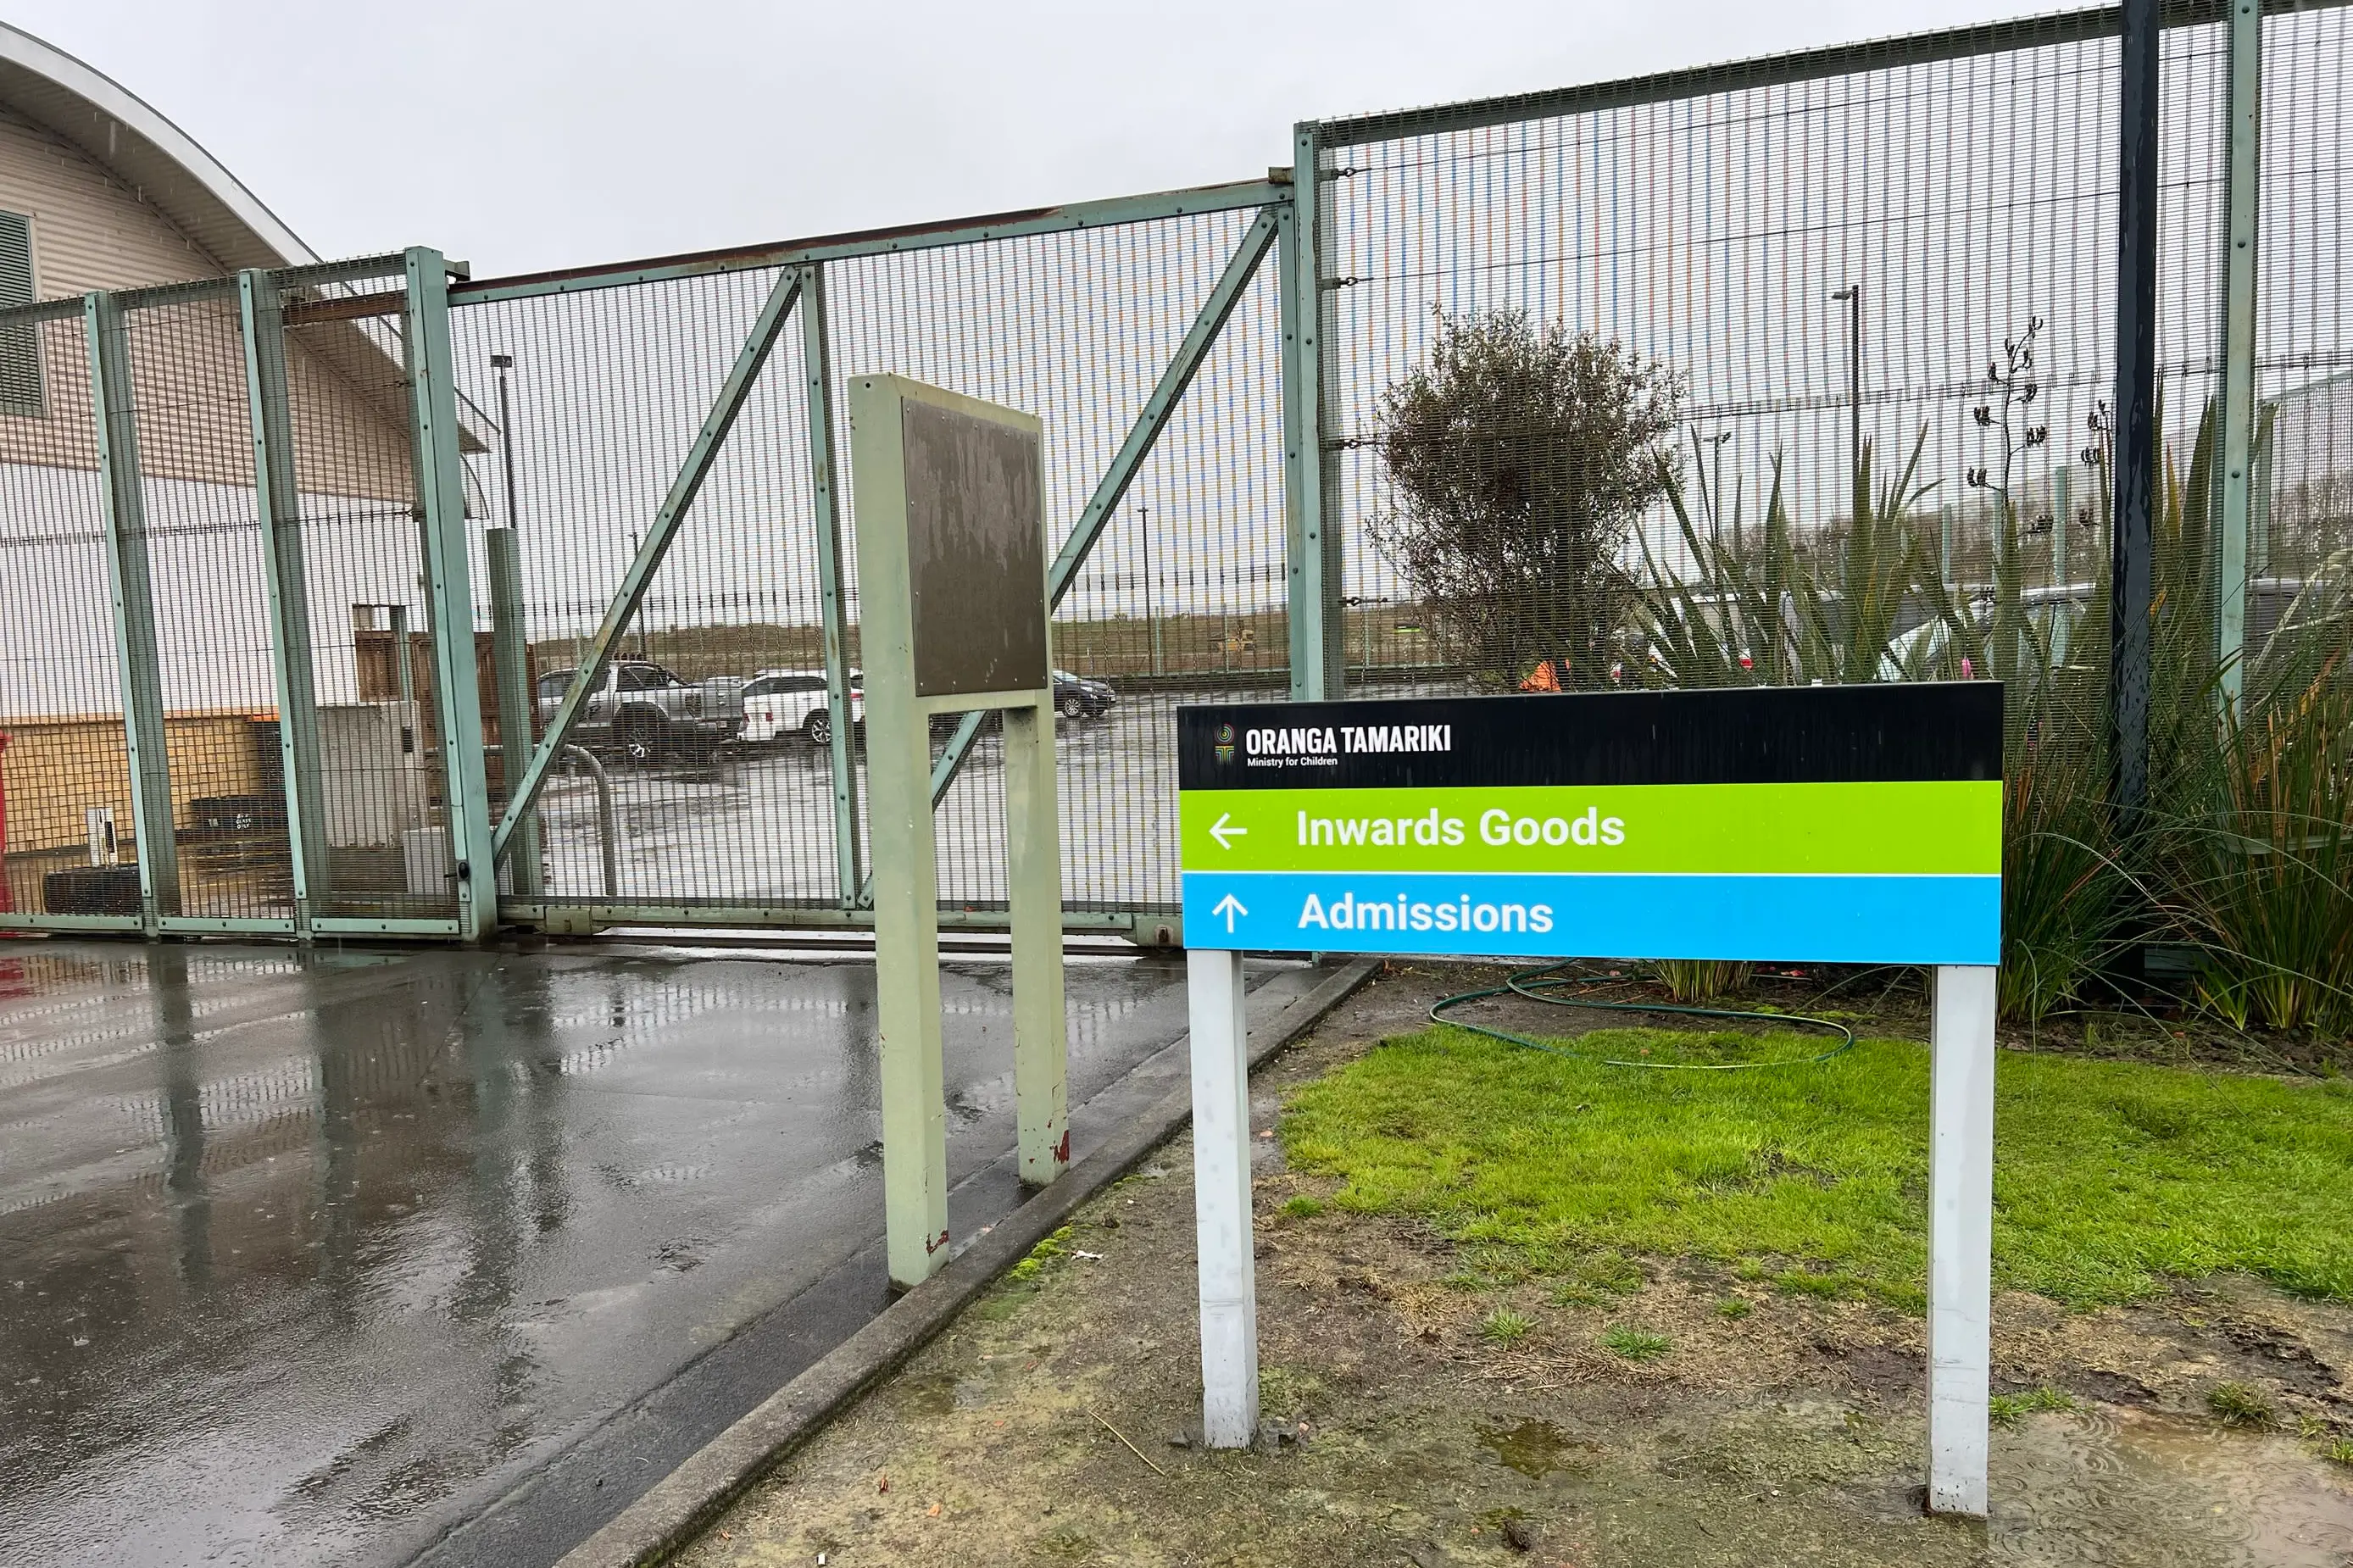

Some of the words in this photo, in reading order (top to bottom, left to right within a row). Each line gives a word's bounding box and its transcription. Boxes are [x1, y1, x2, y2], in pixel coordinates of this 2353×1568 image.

[1246, 727, 1338, 755] ORANGA
[1340, 725, 1451, 753] TAMARIKI
[1247, 757, 1283, 769] Ministry
[1285, 756, 1299, 766] for
[1300, 755, 1338, 766] Children
[1298, 807, 1466, 846] Inwards
[1479, 806, 1626, 846] Goods
[1298, 892, 1554, 933] Admissions
